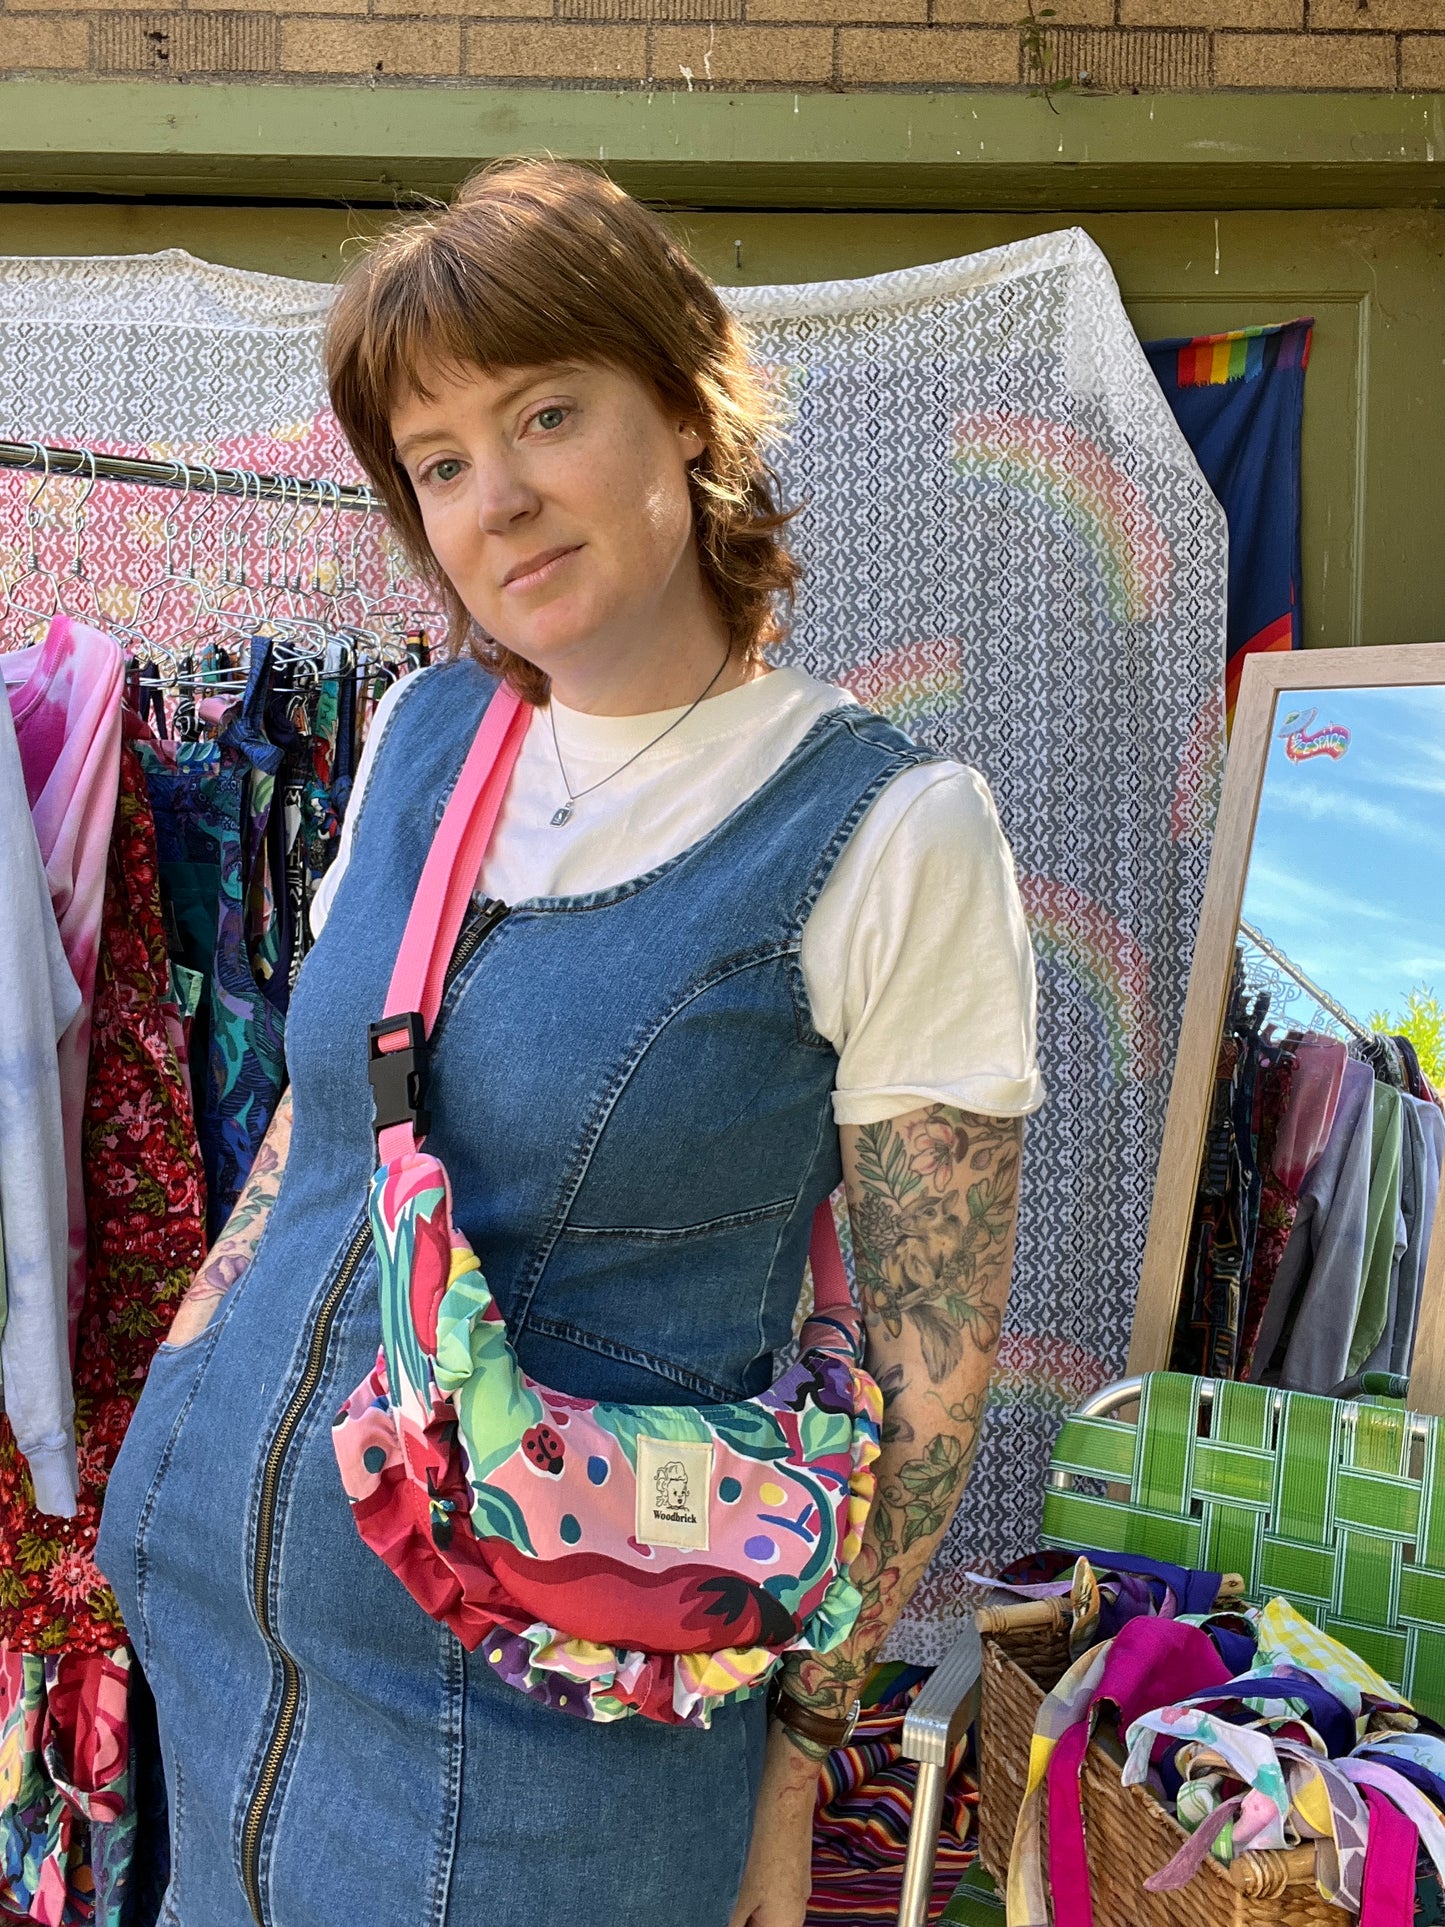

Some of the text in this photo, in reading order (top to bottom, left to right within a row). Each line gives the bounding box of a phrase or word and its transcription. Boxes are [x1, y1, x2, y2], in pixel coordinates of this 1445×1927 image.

[1291, 733, 1346, 755] SAFE SPACE
[652, 1510, 697, 1524] Woodbrick
